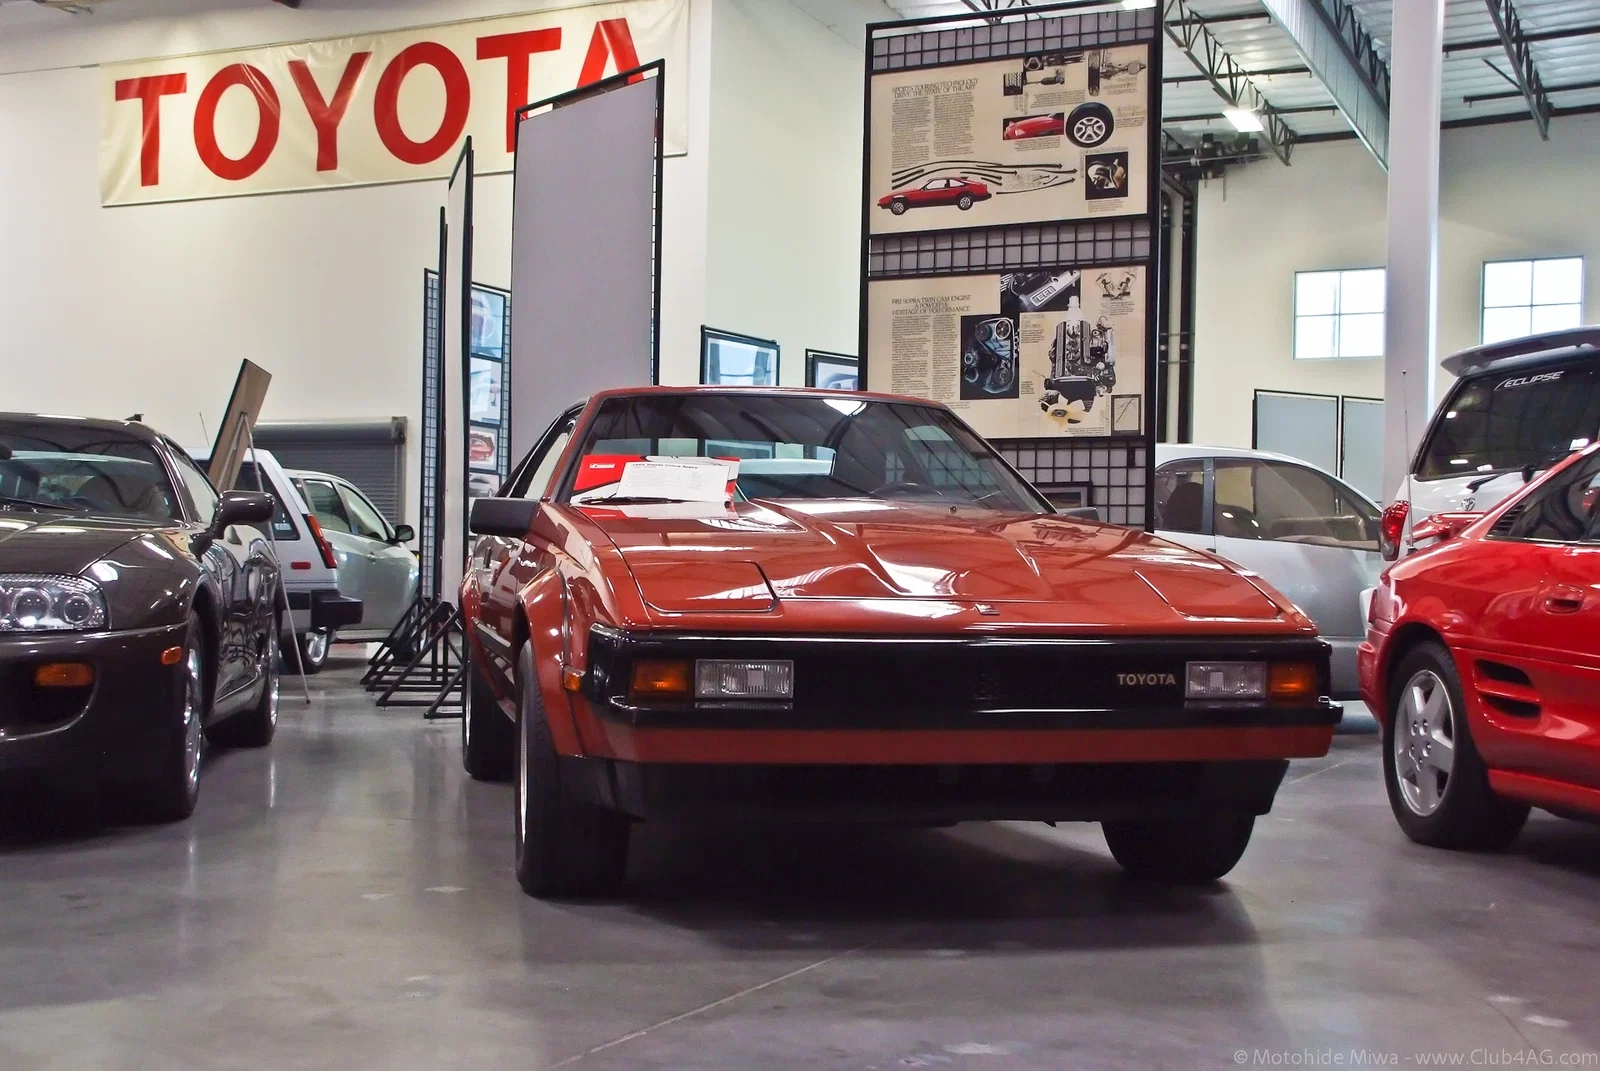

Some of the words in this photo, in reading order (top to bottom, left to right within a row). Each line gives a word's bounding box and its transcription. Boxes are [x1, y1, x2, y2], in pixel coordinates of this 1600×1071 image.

[892, 86, 914, 94] SPORTS
[914, 83, 940, 92] TOURING
[940, 78, 979, 88] TECHNOLOGY
[925, 88, 940, 96] STATE
[115, 18, 645, 187] TOYOTA
[892, 308, 919, 316] HERITAGE
[920, 307, 927, 315] OF
[928, 305, 971, 315] PERFORMANCE
[1503, 371, 1565, 388] ECLIPSE
[1117, 673, 1176, 686] TOYOTA
